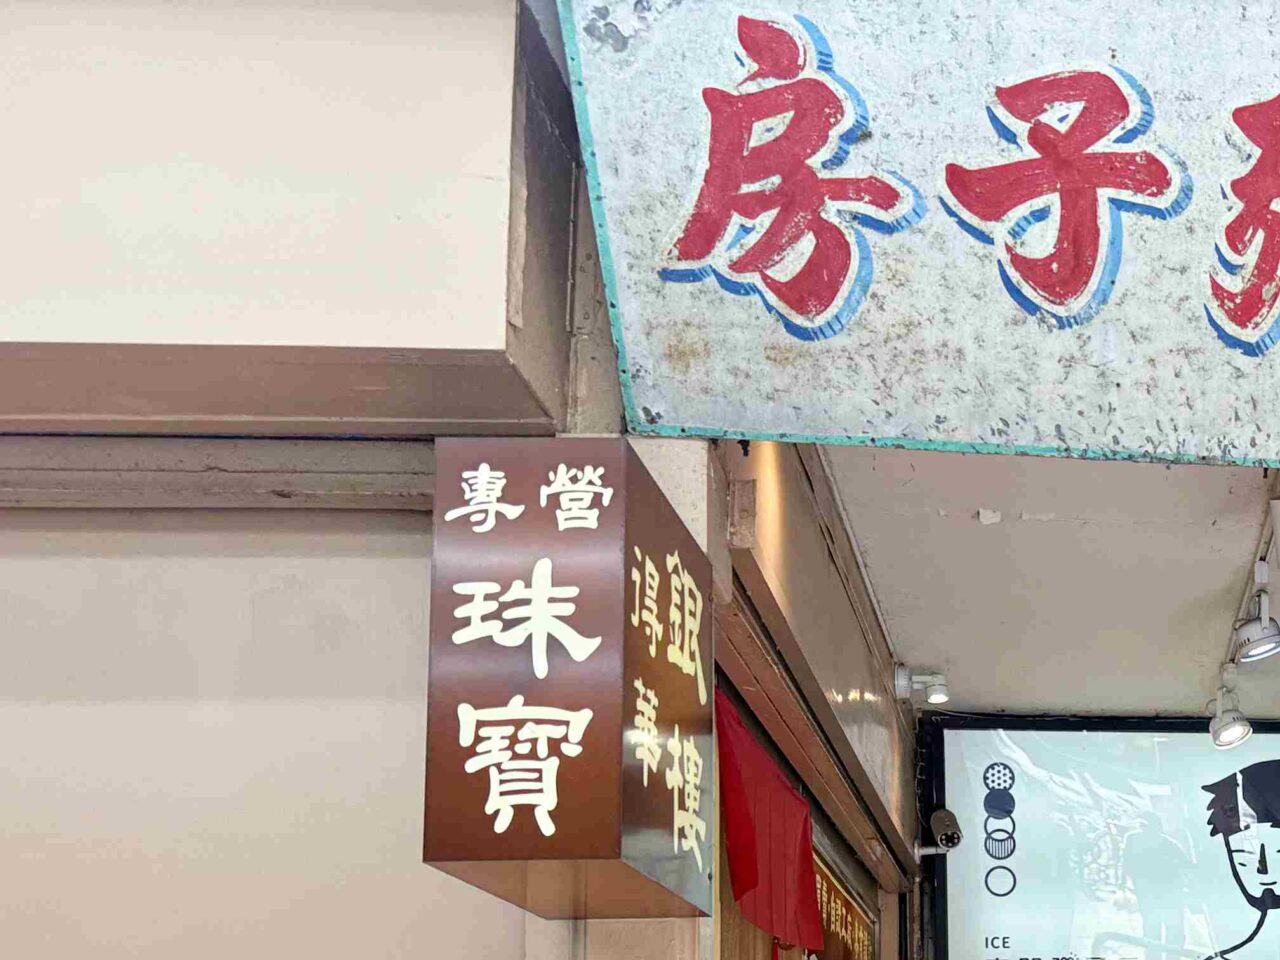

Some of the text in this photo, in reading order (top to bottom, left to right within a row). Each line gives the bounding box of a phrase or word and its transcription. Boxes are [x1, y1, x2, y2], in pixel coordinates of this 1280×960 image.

[444, 462, 615, 533] 專營
[451, 557, 602, 837] 珠寶
[665, 549, 711, 872] 銀樓
[984, 936, 1012, 950] ICE
